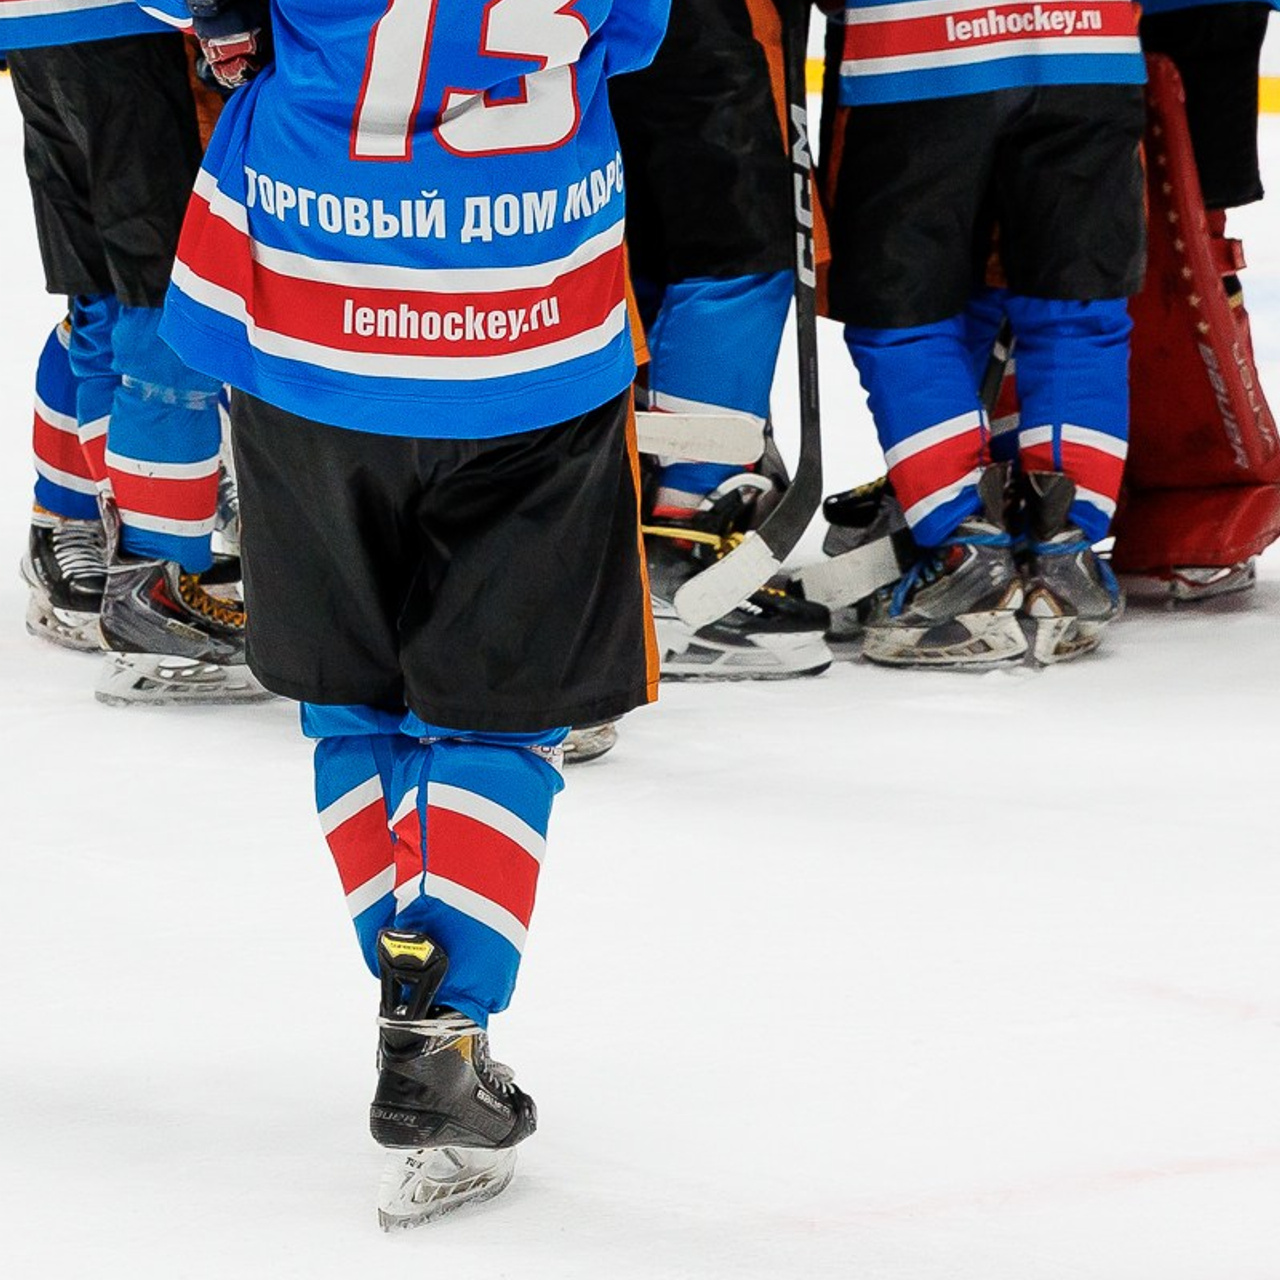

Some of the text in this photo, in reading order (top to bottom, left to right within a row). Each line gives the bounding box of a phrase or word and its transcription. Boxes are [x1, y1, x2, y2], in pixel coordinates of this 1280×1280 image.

[945, 4, 1103, 43] lenhockey.ru
[244, 165, 447, 239] ТОРГОВЫЙ
[460, 188, 558, 244] ДОМ
[791, 103, 817, 289] CCM
[343, 296, 561, 342] lenhockey.ru
